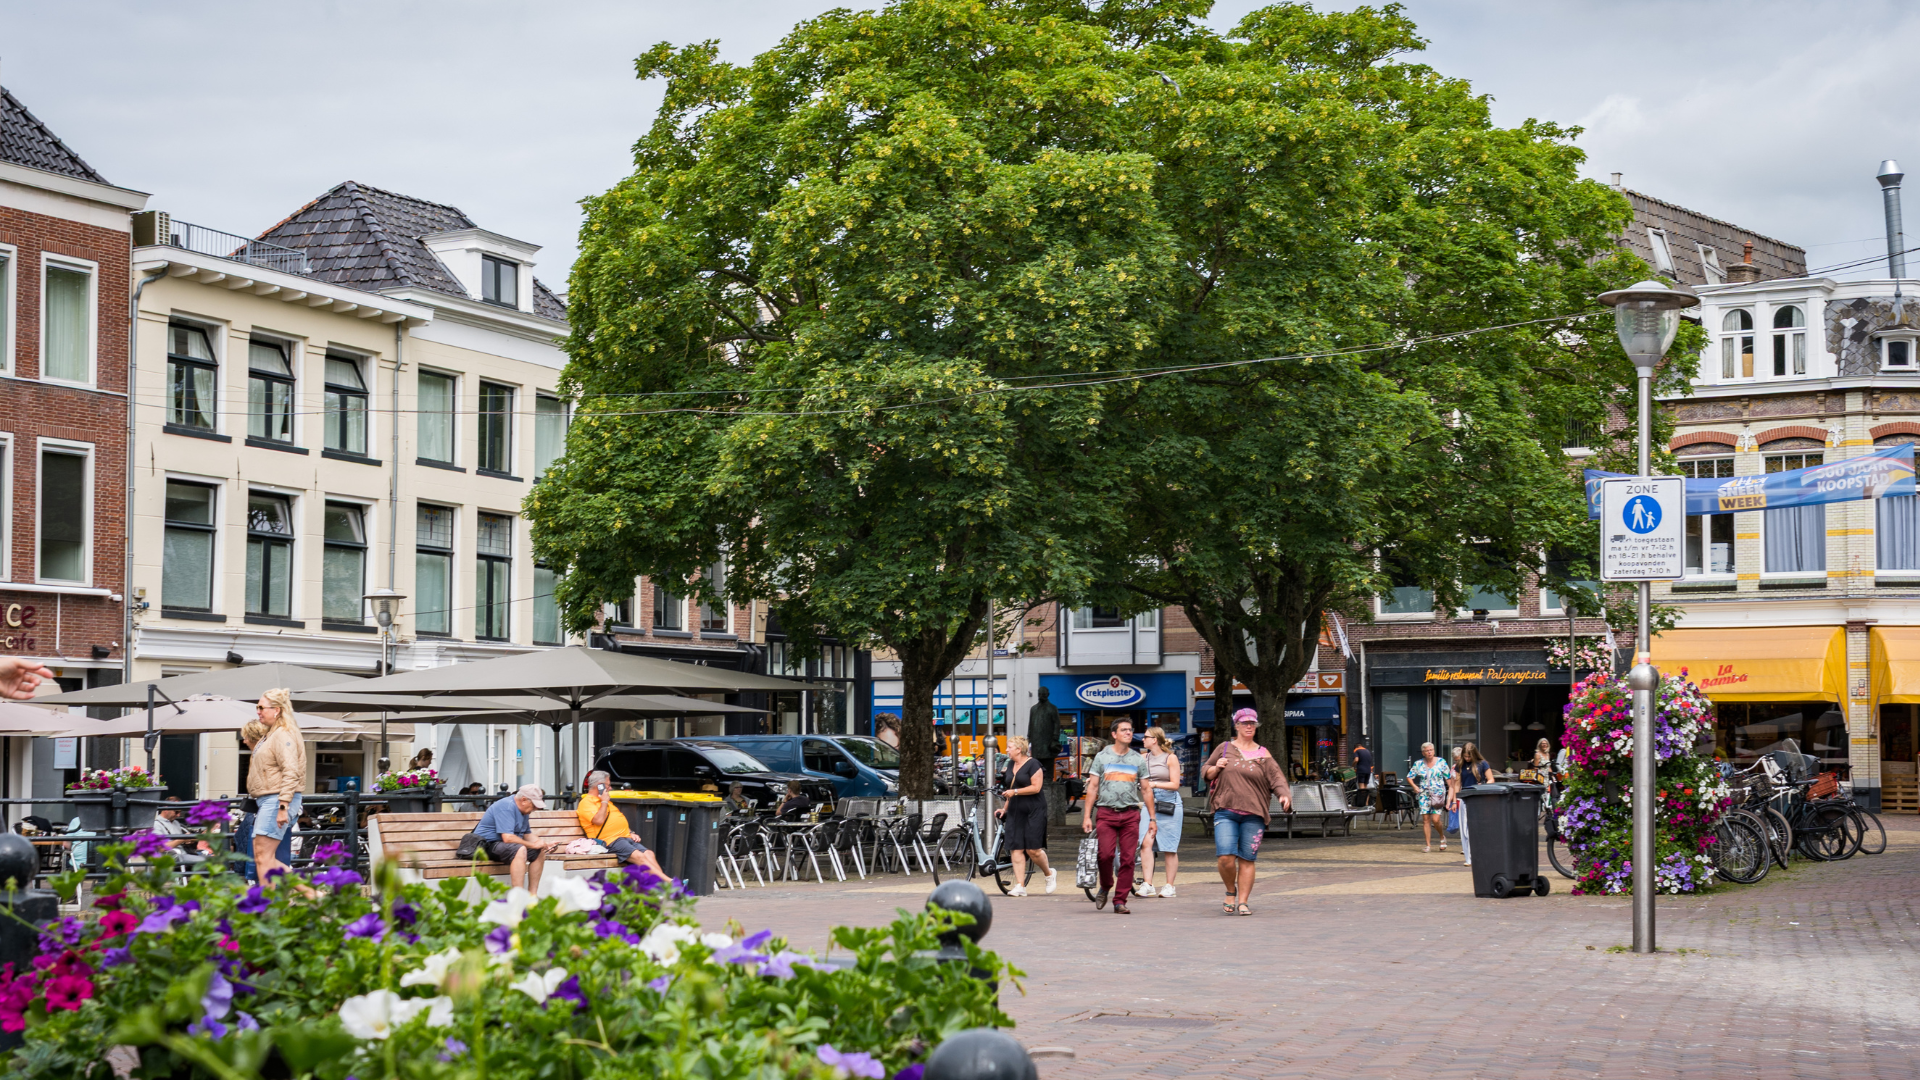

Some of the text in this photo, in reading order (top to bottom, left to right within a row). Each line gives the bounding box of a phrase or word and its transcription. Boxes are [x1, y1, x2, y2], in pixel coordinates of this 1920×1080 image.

[1848, 461, 1889, 476] JAAR
[1626, 485, 1658, 494] ZONE
[1717, 483, 1766, 498] SNEEK
[1817, 473, 1890, 493] KOOPSTAD
[1721, 496, 1764, 509] WEEK
[0, 603, 37, 628] ce
[1423, 667, 1547, 684] familie restaurant Palyanytsia
[1717, 664, 1733, 676] La
[1700, 673, 1749, 690] Bamba
[1086, 689, 1132, 698] trekpleister
